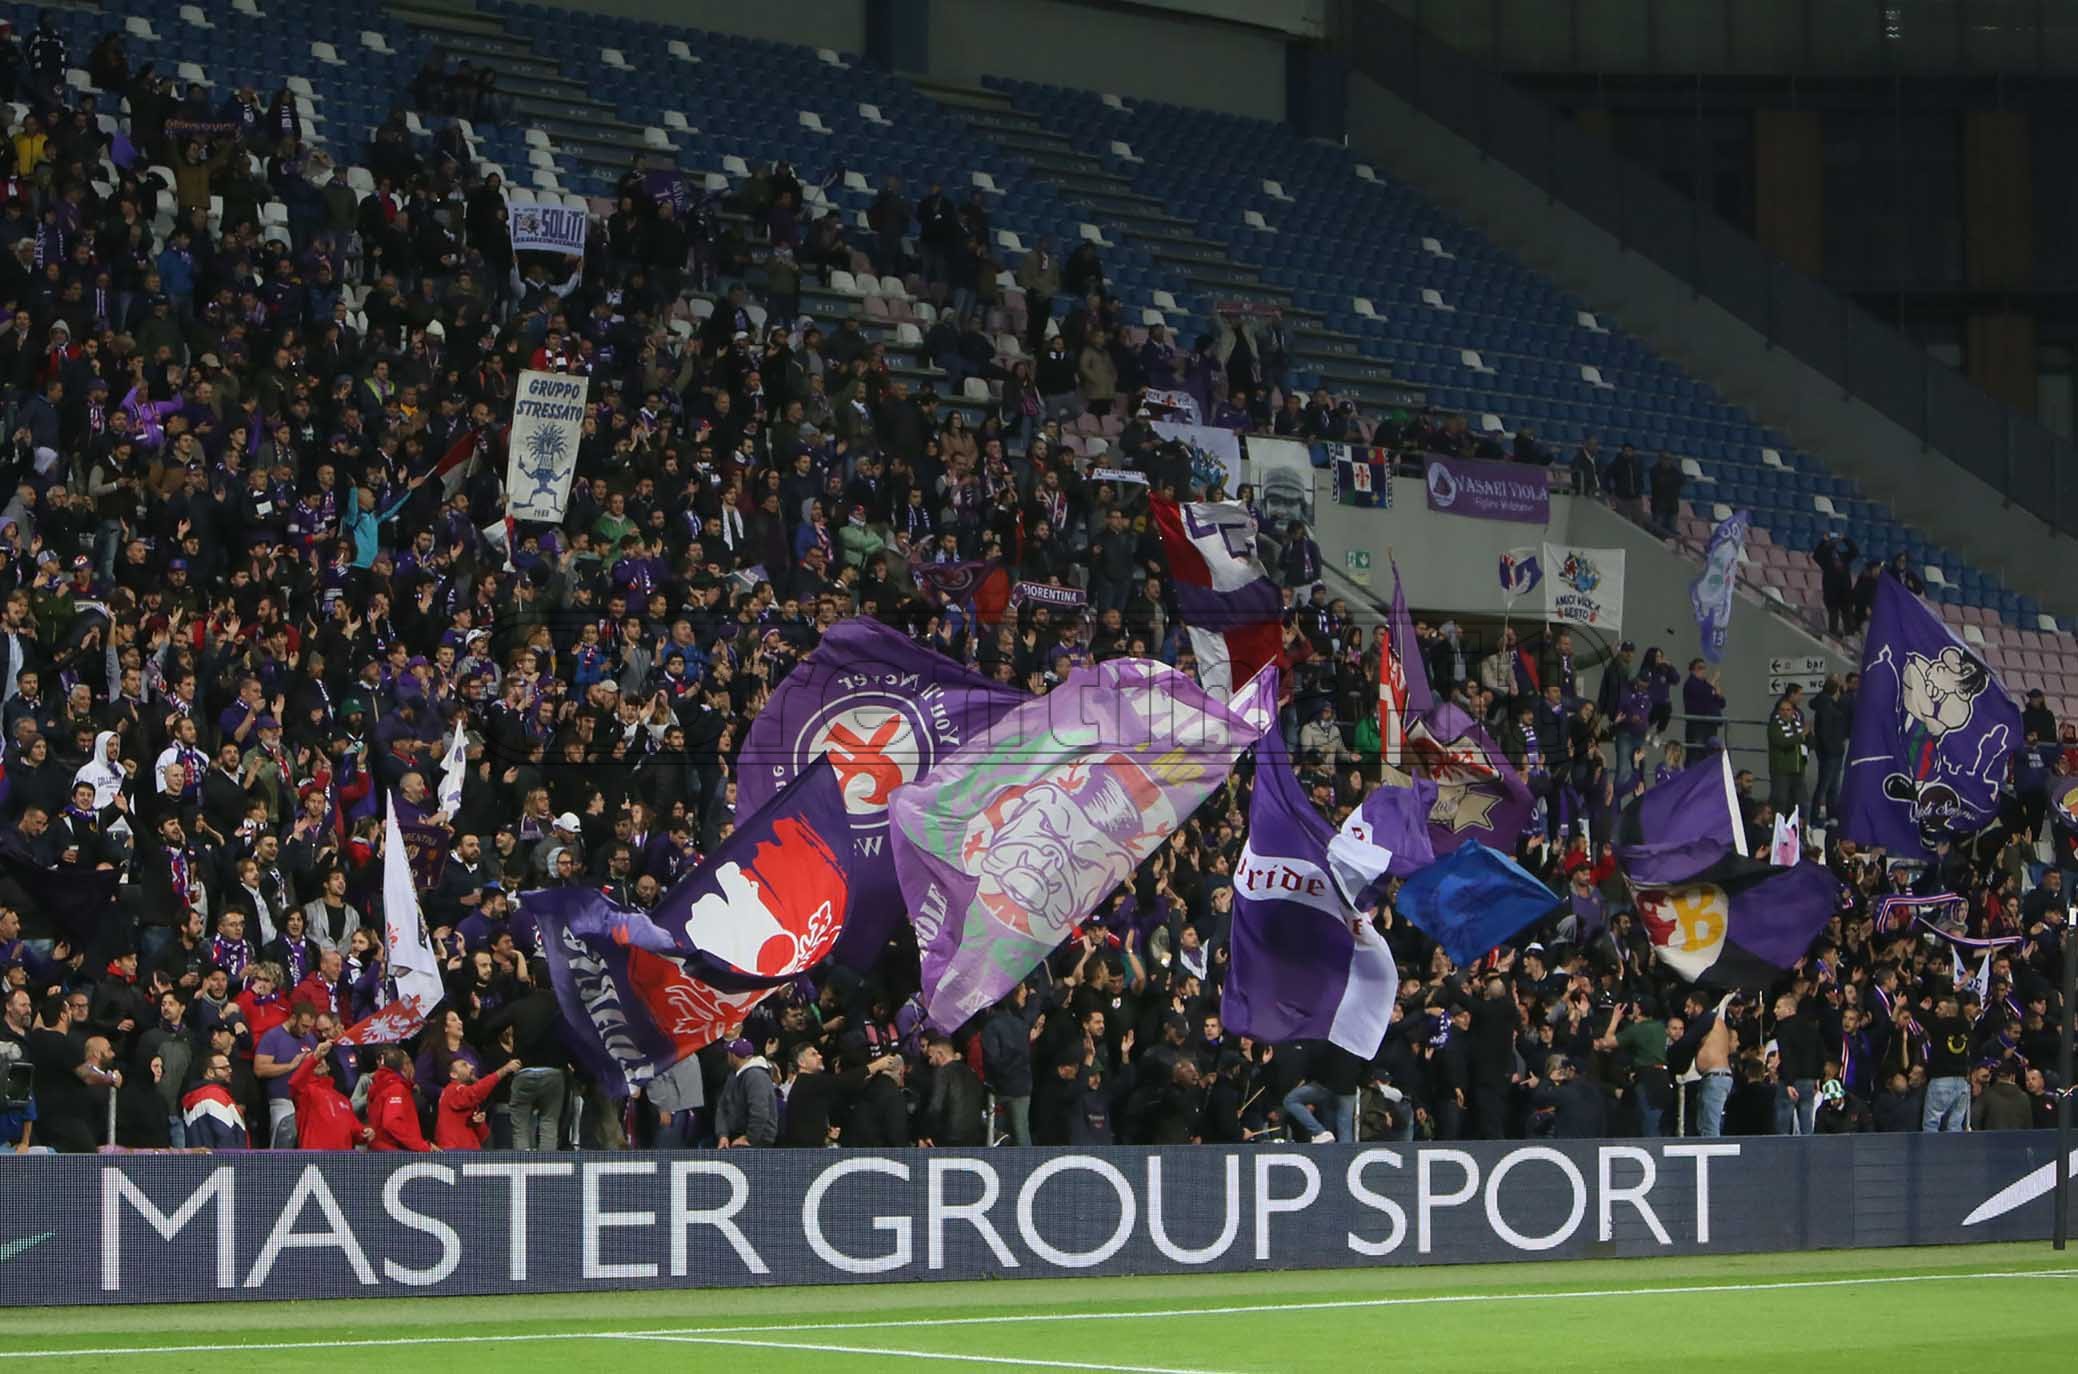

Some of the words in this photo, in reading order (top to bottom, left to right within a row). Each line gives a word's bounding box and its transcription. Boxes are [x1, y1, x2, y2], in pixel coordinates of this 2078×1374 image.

[528, 379, 581, 400] GRUPPO
[516, 400, 584, 422] STRESSATO
[1806, 658, 1824, 671] bar
[101, 1160, 770, 1291] MASTER
[803, 1154, 1322, 1275] GROUP
[1347, 1144, 1740, 1257] SPORT
